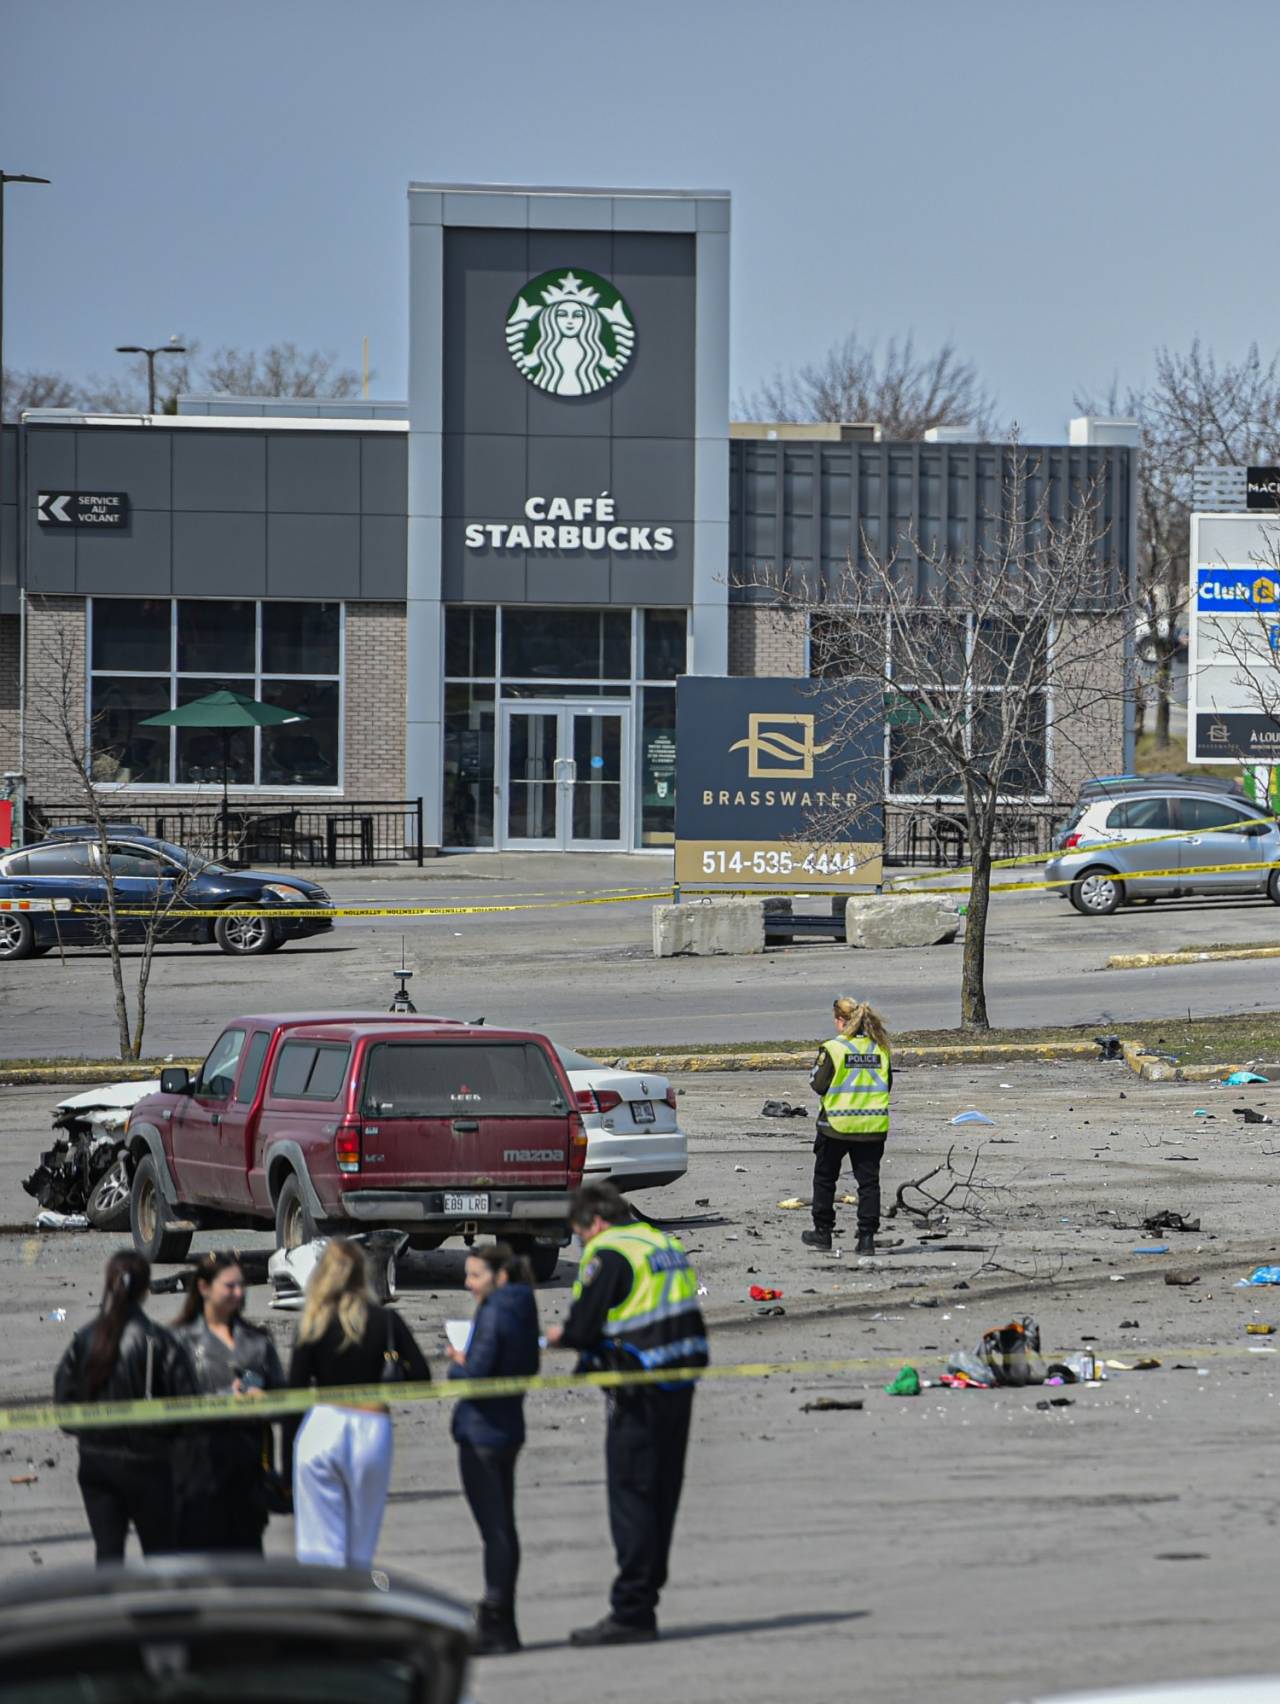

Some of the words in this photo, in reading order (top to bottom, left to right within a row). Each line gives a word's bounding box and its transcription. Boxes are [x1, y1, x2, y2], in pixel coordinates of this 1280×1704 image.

[78, 496, 120, 506] SERVICE
[525, 491, 615, 521] CAFÉ
[78, 513, 120, 522] VOLANT
[465, 524, 674, 551] STARBUCKS
[1199, 582, 1250, 600] Club
[1249, 730, 1258, 743] À
[702, 790, 858, 807] BRASSWATER
[702, 851, 857, 875] 514-535-4444
[847, 1054, 878, 1063] POLICE
[503, 1150, 564, 1162] mazda
